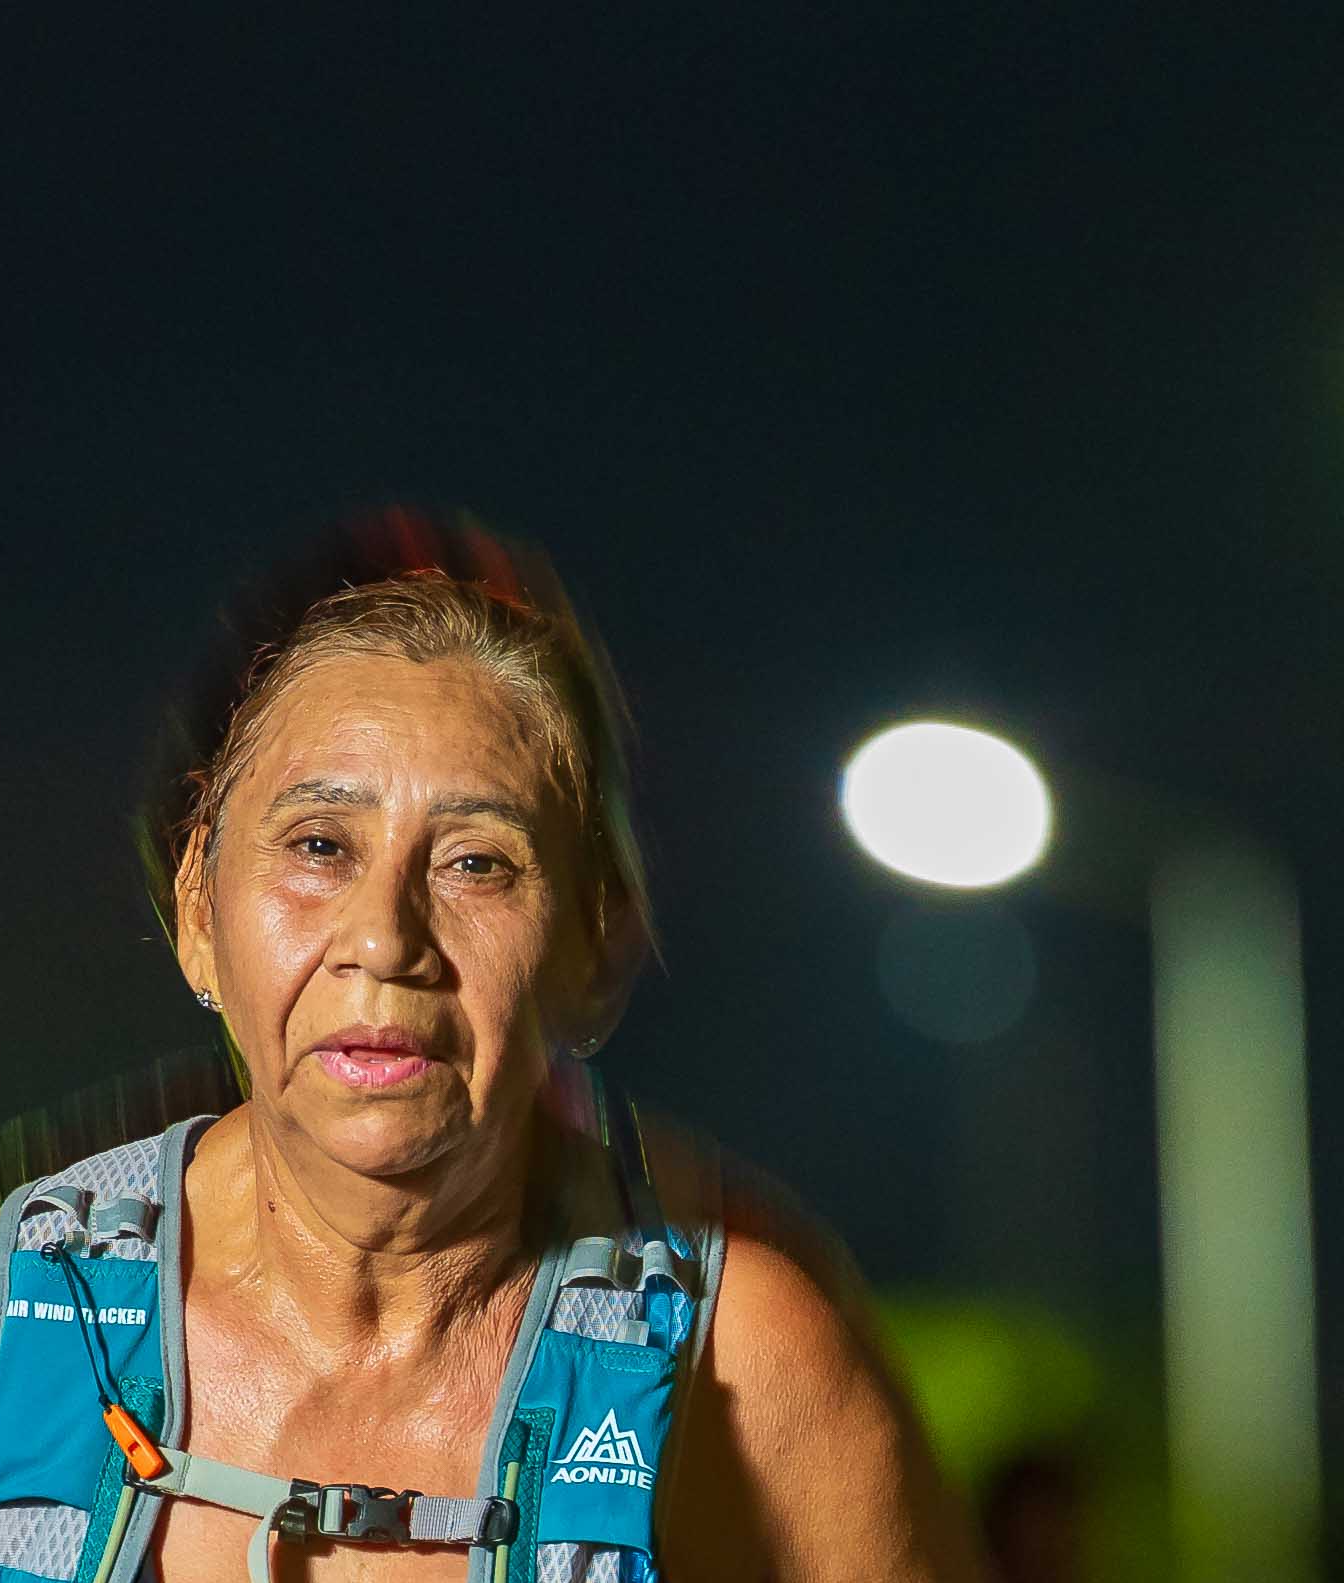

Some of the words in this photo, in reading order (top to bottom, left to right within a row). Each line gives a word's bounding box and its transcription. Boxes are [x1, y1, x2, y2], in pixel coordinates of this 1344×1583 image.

[6, 1299, 29, 1318] AIR
[34, 1302, 74, 1322] WIND
[550, 1467, 654, 1490] AONIJIE
